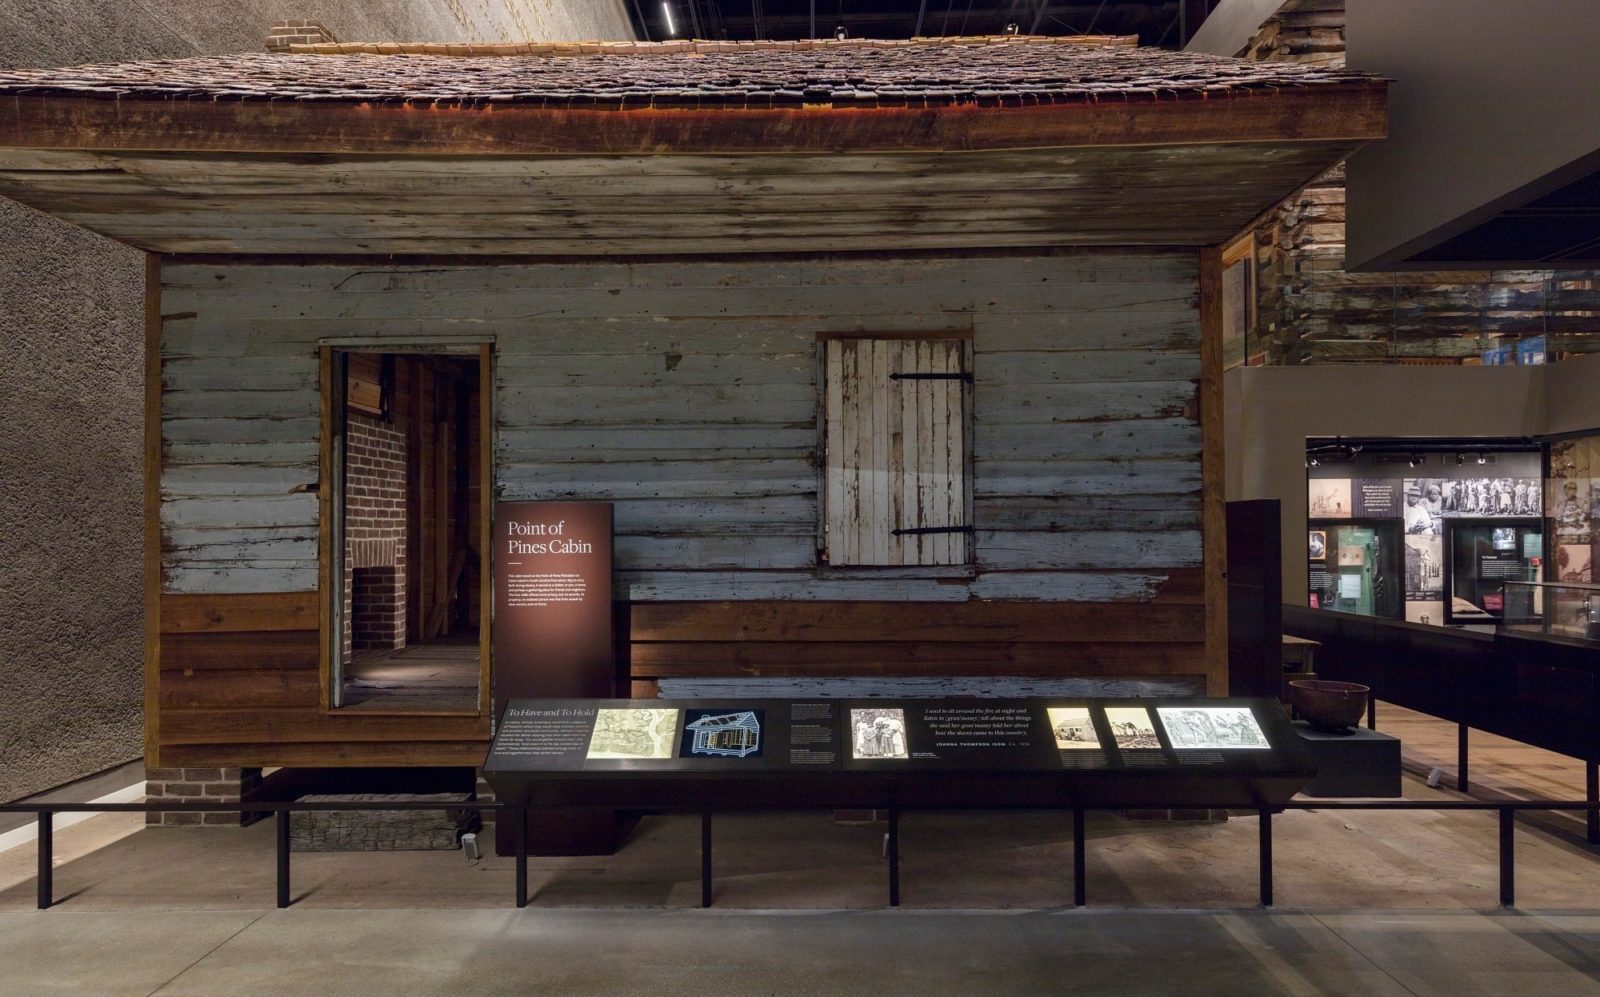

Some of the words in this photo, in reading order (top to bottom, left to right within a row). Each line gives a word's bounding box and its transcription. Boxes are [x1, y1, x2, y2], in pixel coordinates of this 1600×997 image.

[508, 521, 546, 536] Point
[548, 520, 565, 536] of
[508, 540, 547, 554] Pines
[549, 538, 592, 554] Cabin
